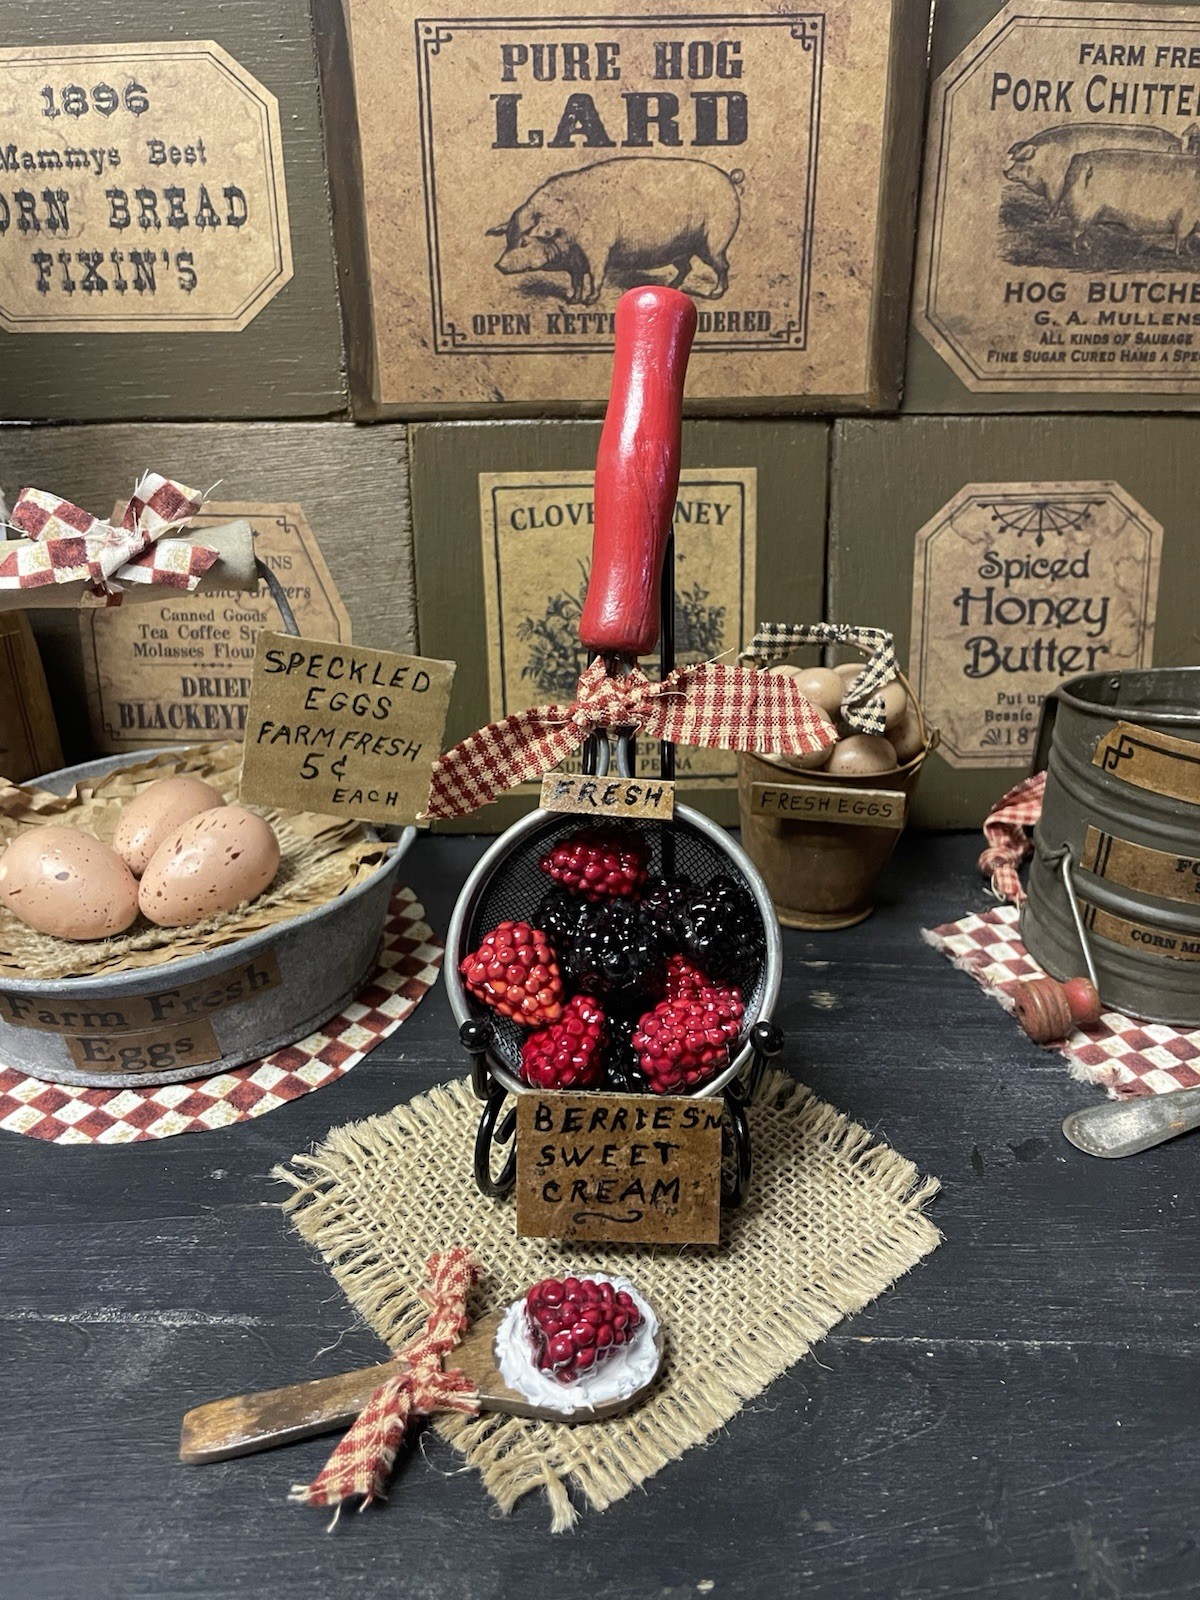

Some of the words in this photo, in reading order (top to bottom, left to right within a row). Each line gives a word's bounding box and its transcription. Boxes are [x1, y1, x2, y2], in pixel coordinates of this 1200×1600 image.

[500, 42, 621, 82] PURE
[653, 40, 743, 80] HOG
[1079, 43, 1145, 68] FARM
[40, 82, 150, 120] 1896
[990, 72, 1074, 113] PORK
[1086, 74, 1200, 116] CHITTE
[490, 91, 748, 150] LARD
[0, 143, 121, 176] Mammys
[146, 136, 207, 167] Best
[105, 183, 248, 234] BREAD
[32, 246, 198, 296] FIXIN'S
[1004, 282, 1067, 303] HOG
[472, 313, 531, 336] OPEN
[1034, 310, 1057, 326] G.
[1065, 310, 1087, 326] A.
[1039, 332, 1065, 345] ALL
[1070, 333, 1109, 346] KINDS
[1113, 333, 1131, 346] OF
[1134, 331, 1194, 346] SAUSAGE
[987, 350, 1018, 363] FINE
[1023, 350, 1067, 363] SUGAR
[1071, 350, 1116, 363] CURED
[1160, 352, 1168, 363] A
[676, 501, 732, 526] NEY
[978, 548, 1090, 588] Spiced
[160, 607, 215, 621] Canned
[223, 608, 268, 622] Goods
[953, 586, 1110, 637] Honey
[138, 624, 169, 640] Tea
[178, 624, 231, 641] Coffee
[133, 642, 205, 659] Molasses
[214, 642, 255, 659] Flou
[963, 635, 1110, 678] Butter
[264, 650, 430, 692] SPECKLED
[304, 686, 392, 719] EGGS
[996, 692, 1022, 706] Put
[258, 720, 336, 748] FARM
[340, 730, 423, 762] FRESH
[332, 788, 399, 806] EACH
[555, 779, 664, 808] FRESH
[761, 791, 831, 812] FRESH
[838, 799, 893, 818] EGGS
[1131, 930, 1177, 949] CORN
[3, 994, 130, 1028] Farm
[144, 963, 272, 1023] Fresh
[76, 1036, 195, 1071] Eggs
[534, 1101, 699, 1133] BERRIES
[536, 1141, 681, 1168] SWEET
[542, 1176, 681, 1205] CREAM
